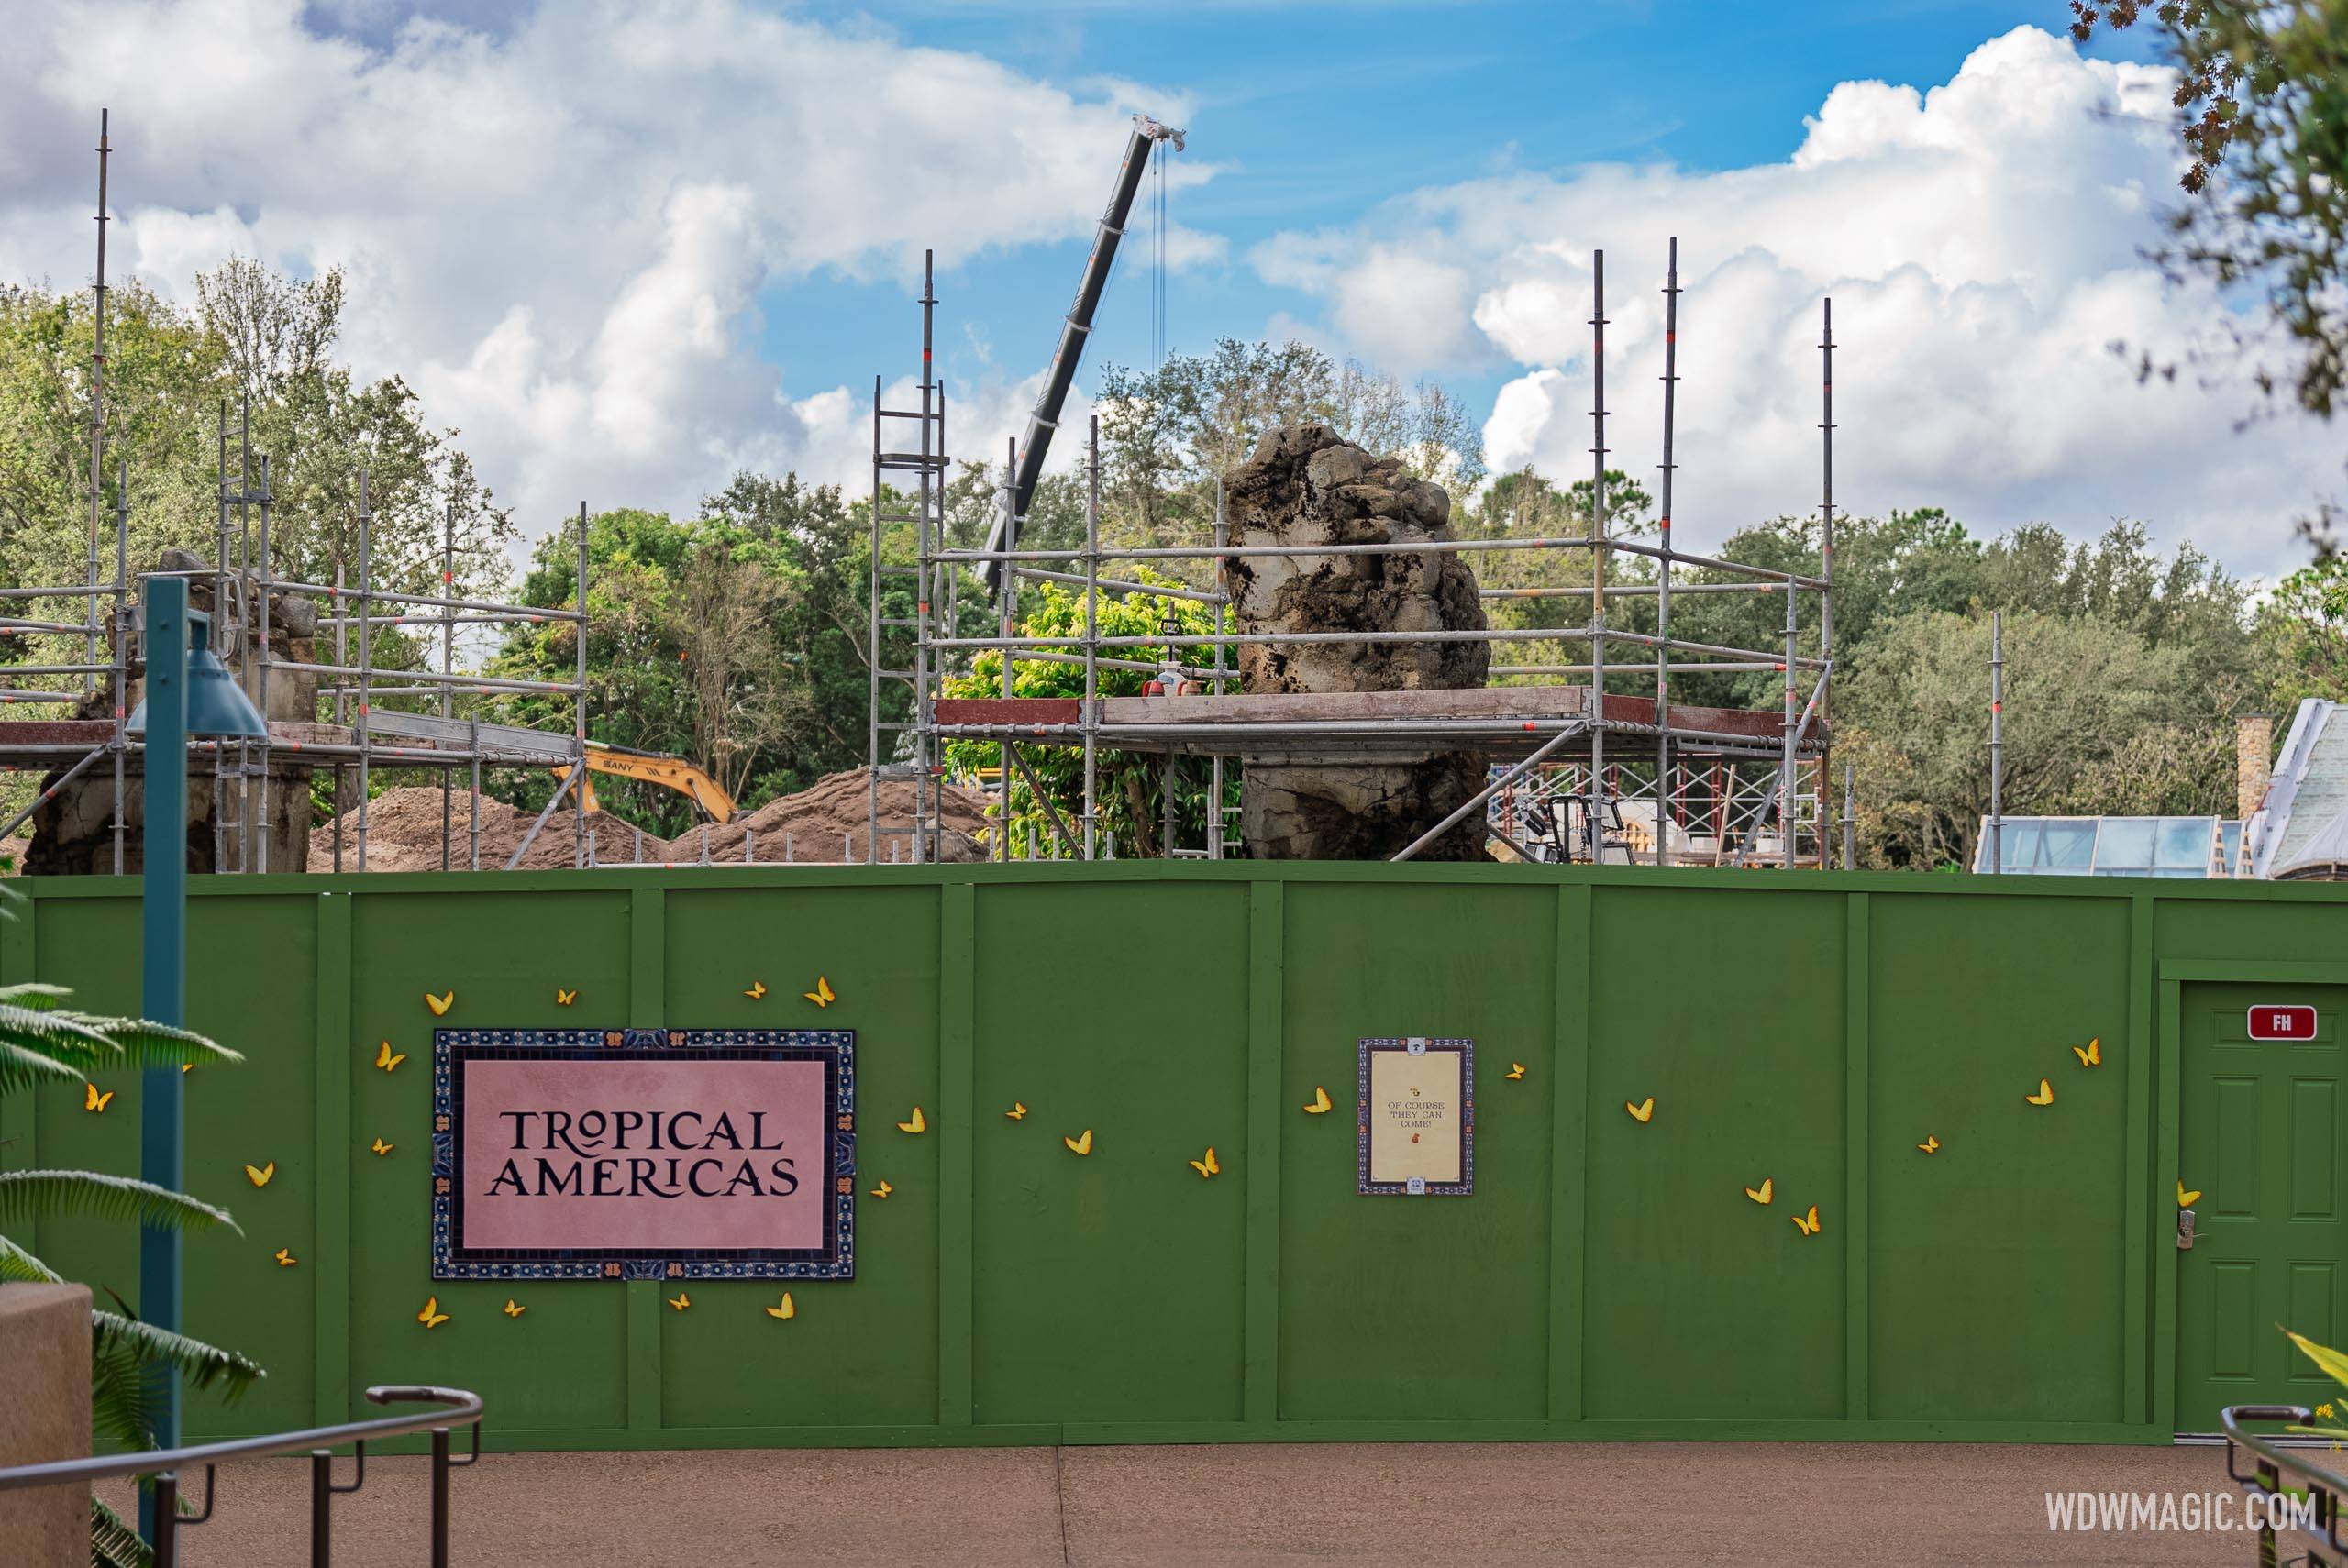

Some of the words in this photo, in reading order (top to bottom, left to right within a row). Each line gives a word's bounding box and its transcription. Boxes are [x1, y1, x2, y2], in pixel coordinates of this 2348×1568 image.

[603, 759, 633, 772] SANY
[2273, 1014, 2292, 1031] FH
[1388, 1101, 1401, 1110] OF
[1404, 1101, 1445, 1110] COURSE
[1390, 1110, 1418, 1119] THEY
[1422, 1110, 1442, 1119] CAN
[1401, 1121, 1432, 1129] COME!
[499, 1110, 784, 1159] TROPICAL
[484, 1157, 799, 1198] AMERICAS
